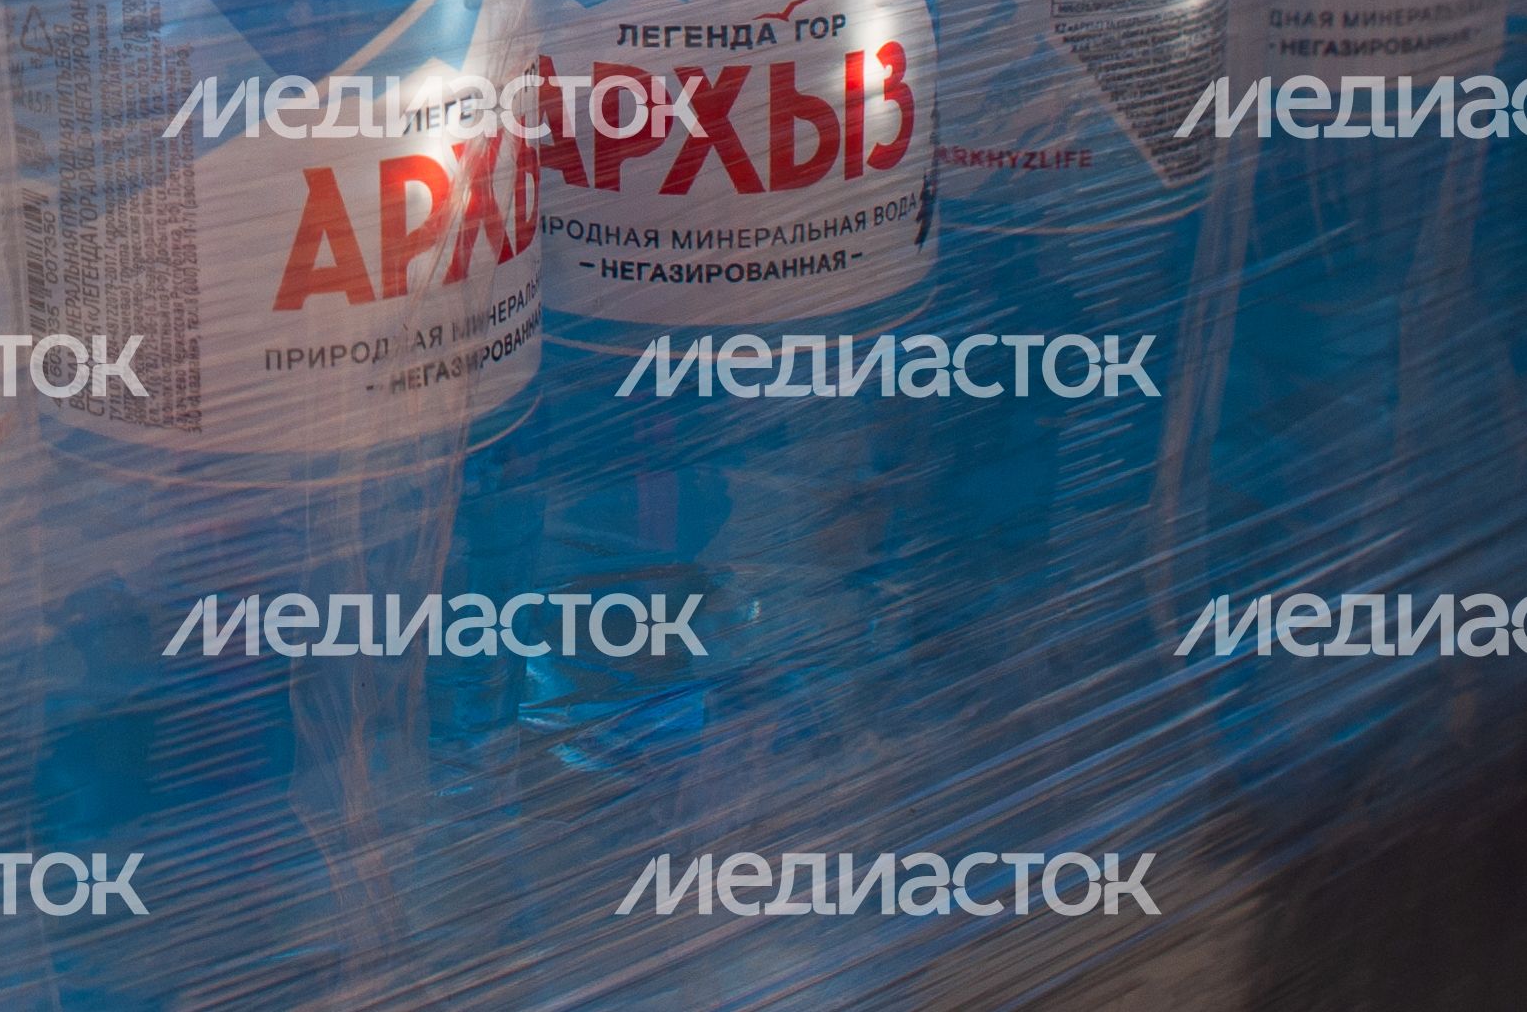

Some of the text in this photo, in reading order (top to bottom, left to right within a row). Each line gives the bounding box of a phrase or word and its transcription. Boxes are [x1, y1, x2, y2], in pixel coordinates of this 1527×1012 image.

[52, 23, 73, 115] ПИТЬЕВАЯ
[617, 13, 847, 50] ЛЕГЕНДА ГОР
[539, 41, 915, 195] АРХЫЗ
[56, 117, 80, 227] ПРИРОДНАЯ
[42, 210, 58, 284] 007350
[672, 211, 867, 250] МИНЕРАЛЬНАЯ
[874, 192, 918, 228] ВОДА
[61, 229, 84, 360] ИНЕРАЛЬНАЯ
[265, 323, 443, 372] ПРИРОДАЯ
